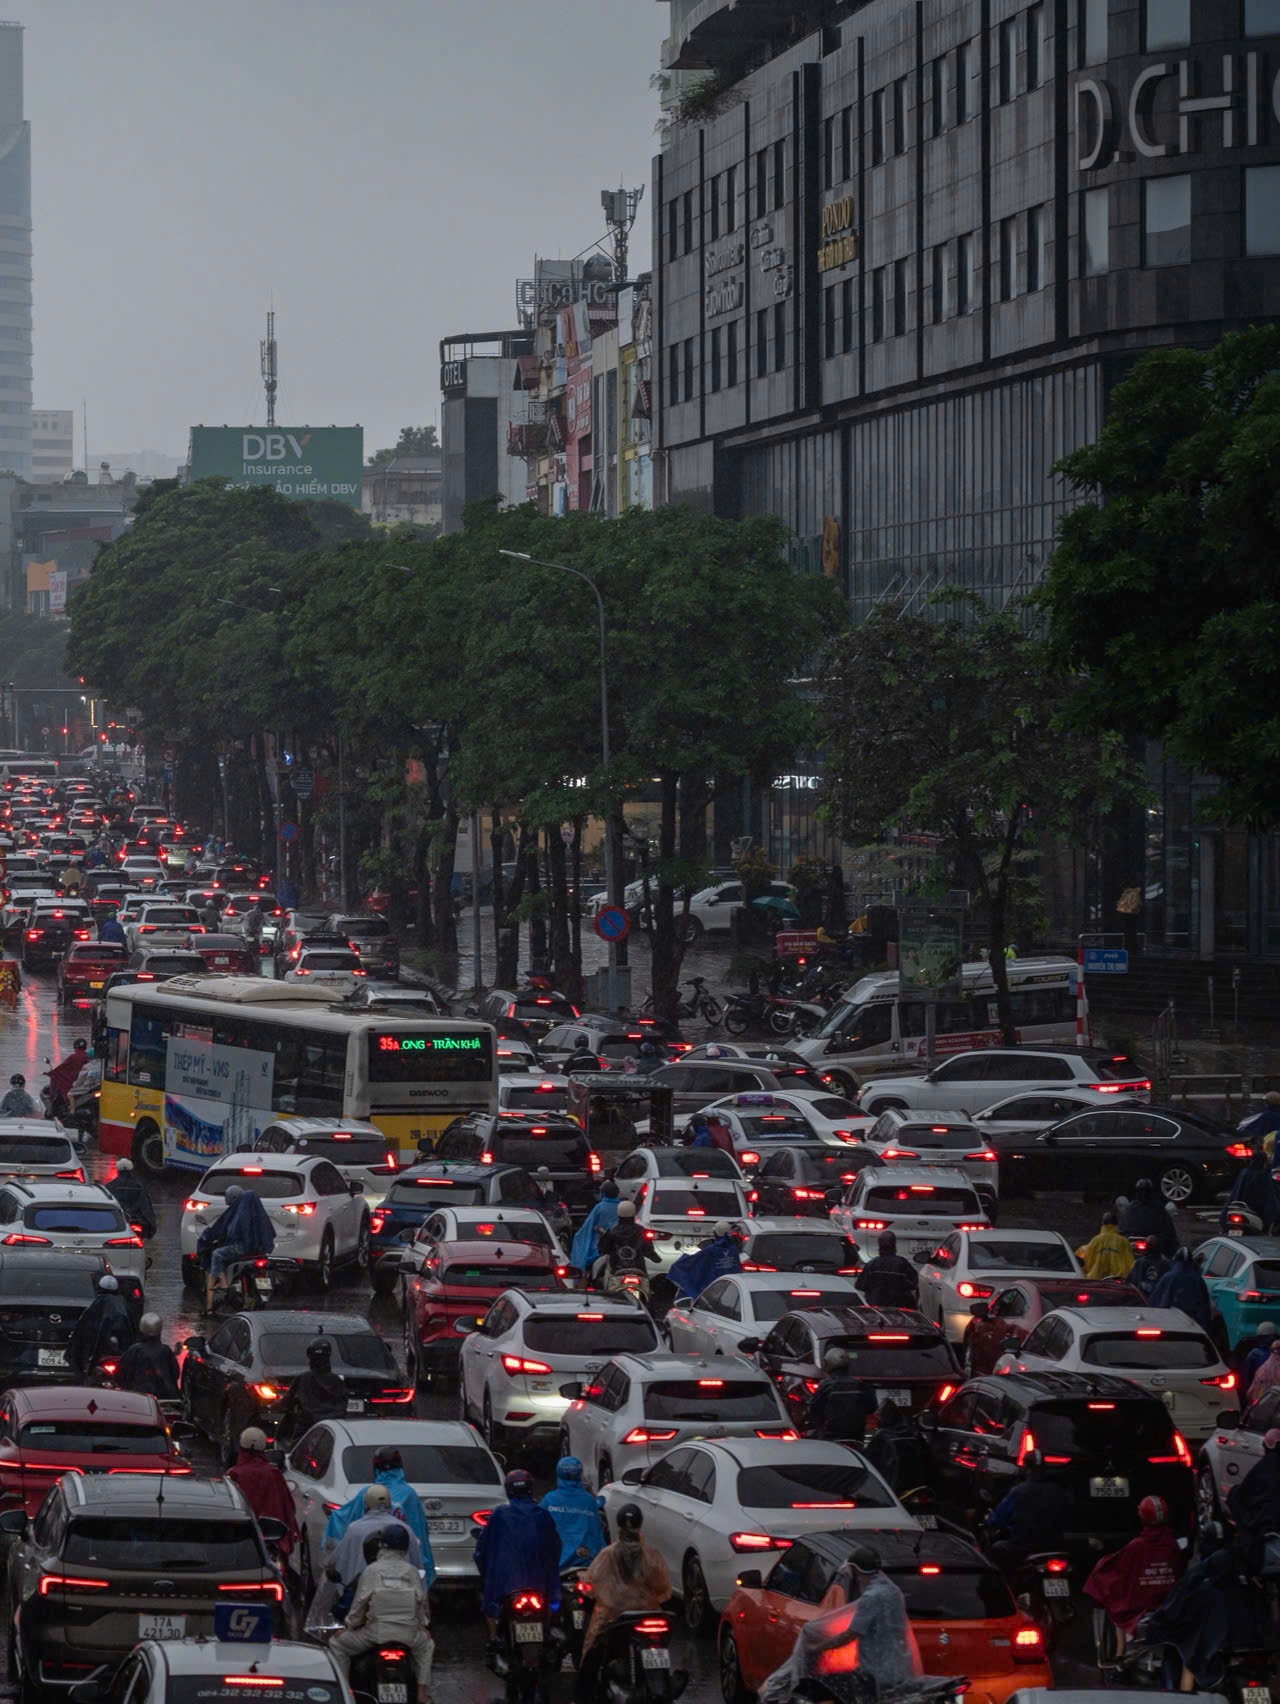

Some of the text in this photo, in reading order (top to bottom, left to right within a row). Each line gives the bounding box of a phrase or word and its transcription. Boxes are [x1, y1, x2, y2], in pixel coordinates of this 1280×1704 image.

[1075, 52, 1280, 170] D.CHI
[242, 434, 311, 460] DBV
[243, 463, 313, 475] Insurance
[296, 478, 327, 494] HIỂM
[331, 484, 357, 495] DBV
[379, 1036, 400, 1051] 35A
[409, 1089, 448, 1097] DAEWOO
[154, 1617, 173, 1628] 17A
[221, 1688, 240, 1697] 32
[242, 1688, 262, 1698] 32
[264, 1689, 284, 1699] 32
[286, 1690, 304, 1700] 32
